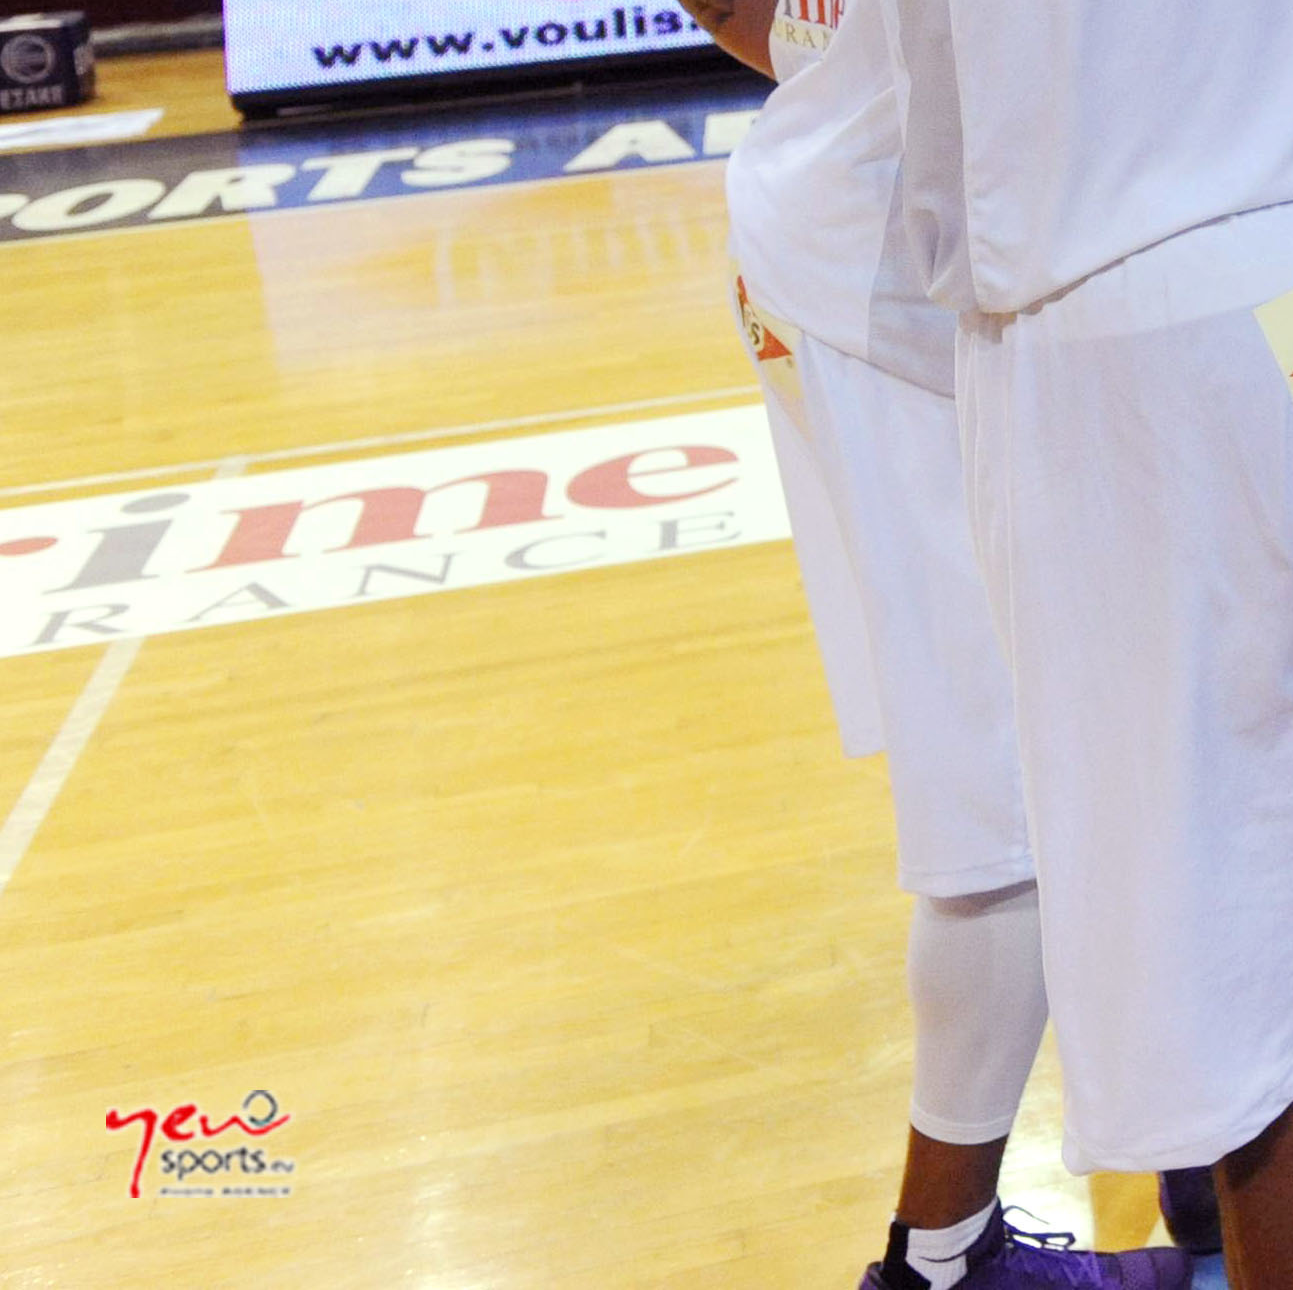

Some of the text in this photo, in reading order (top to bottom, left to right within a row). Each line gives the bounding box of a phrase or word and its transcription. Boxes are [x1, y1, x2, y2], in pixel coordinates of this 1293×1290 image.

[312, 6, 700, 68] www.voulis.
[0, 138, 515, 231] ORTS
[0, 444, 740, 597] ime
[25, 510, 743, 648] RANCE
